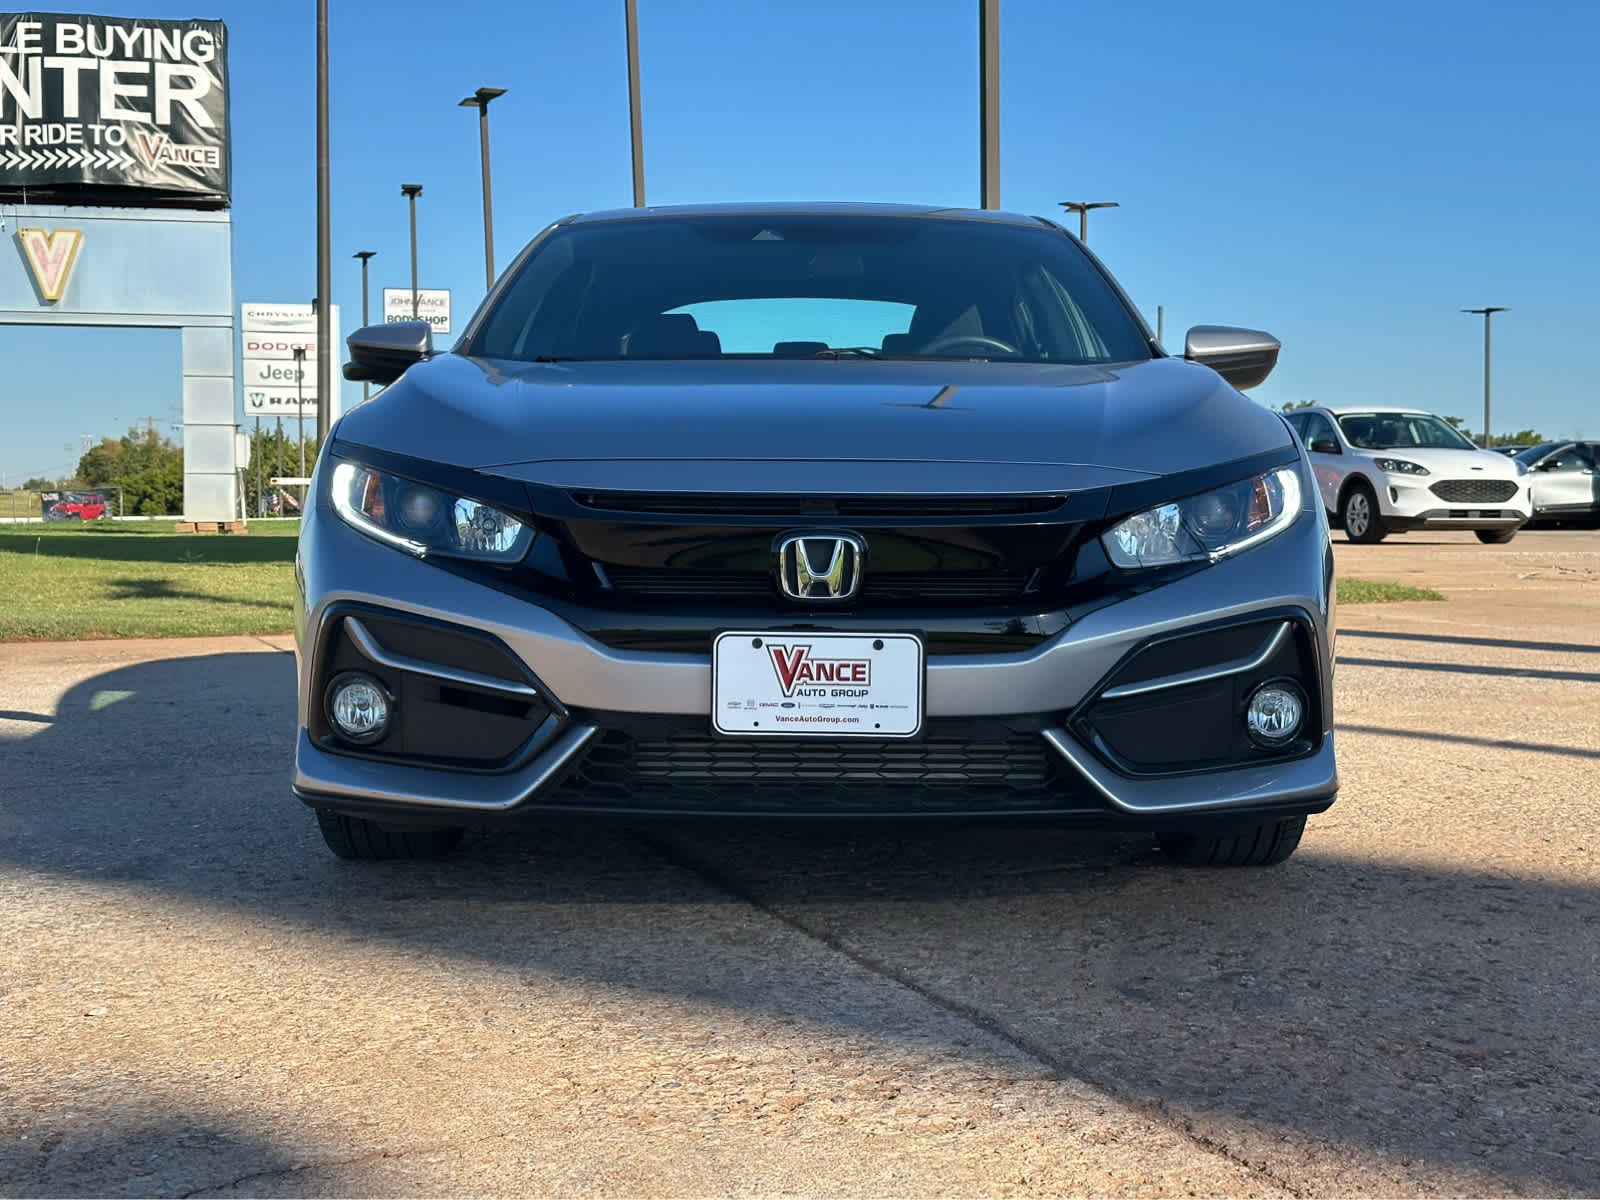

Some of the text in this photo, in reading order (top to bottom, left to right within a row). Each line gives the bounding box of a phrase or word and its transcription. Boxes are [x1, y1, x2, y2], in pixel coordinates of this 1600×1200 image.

[56, 23, 215, 63] BUYING
[0, 56, 216, 128] NTER
[25, 123, 83, 146] RIDE
[88, 124, 126, 146] TO
[136, 131, 218, 169] VANCE
[16, 227, 82, 302] V
[259, 364, 305, 383] Jeep
[269, 397, 318, 405] RAM
[769, 646, 869, 695] VANCE
[796, 688, 869, 698] AUTO GROUP
[775, 715, 860, 724] VanceAutoGroup.com
